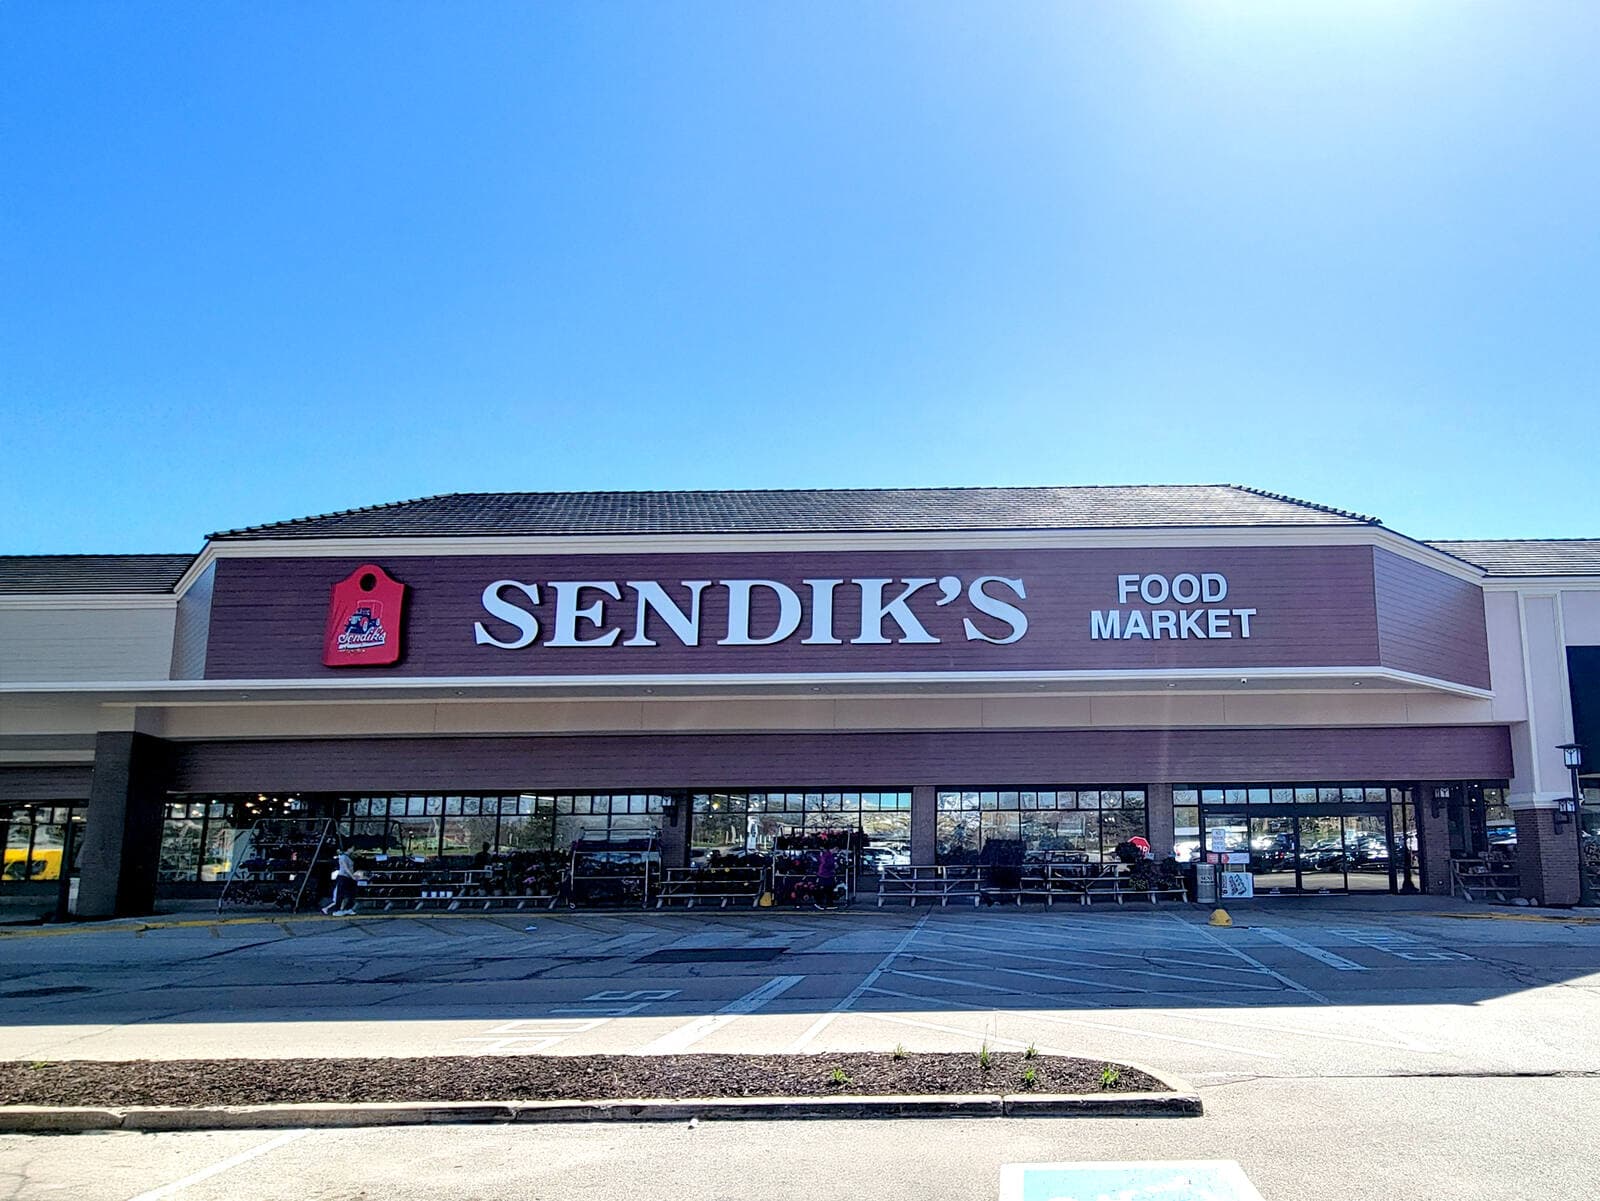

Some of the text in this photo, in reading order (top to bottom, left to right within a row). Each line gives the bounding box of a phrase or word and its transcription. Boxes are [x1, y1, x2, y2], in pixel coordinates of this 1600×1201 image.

[1117, 573, 1228, 605] FOOD
[474, 576, 1028, 649] SENDIK'S
[1090, 608, 1257, 640] MARKET
